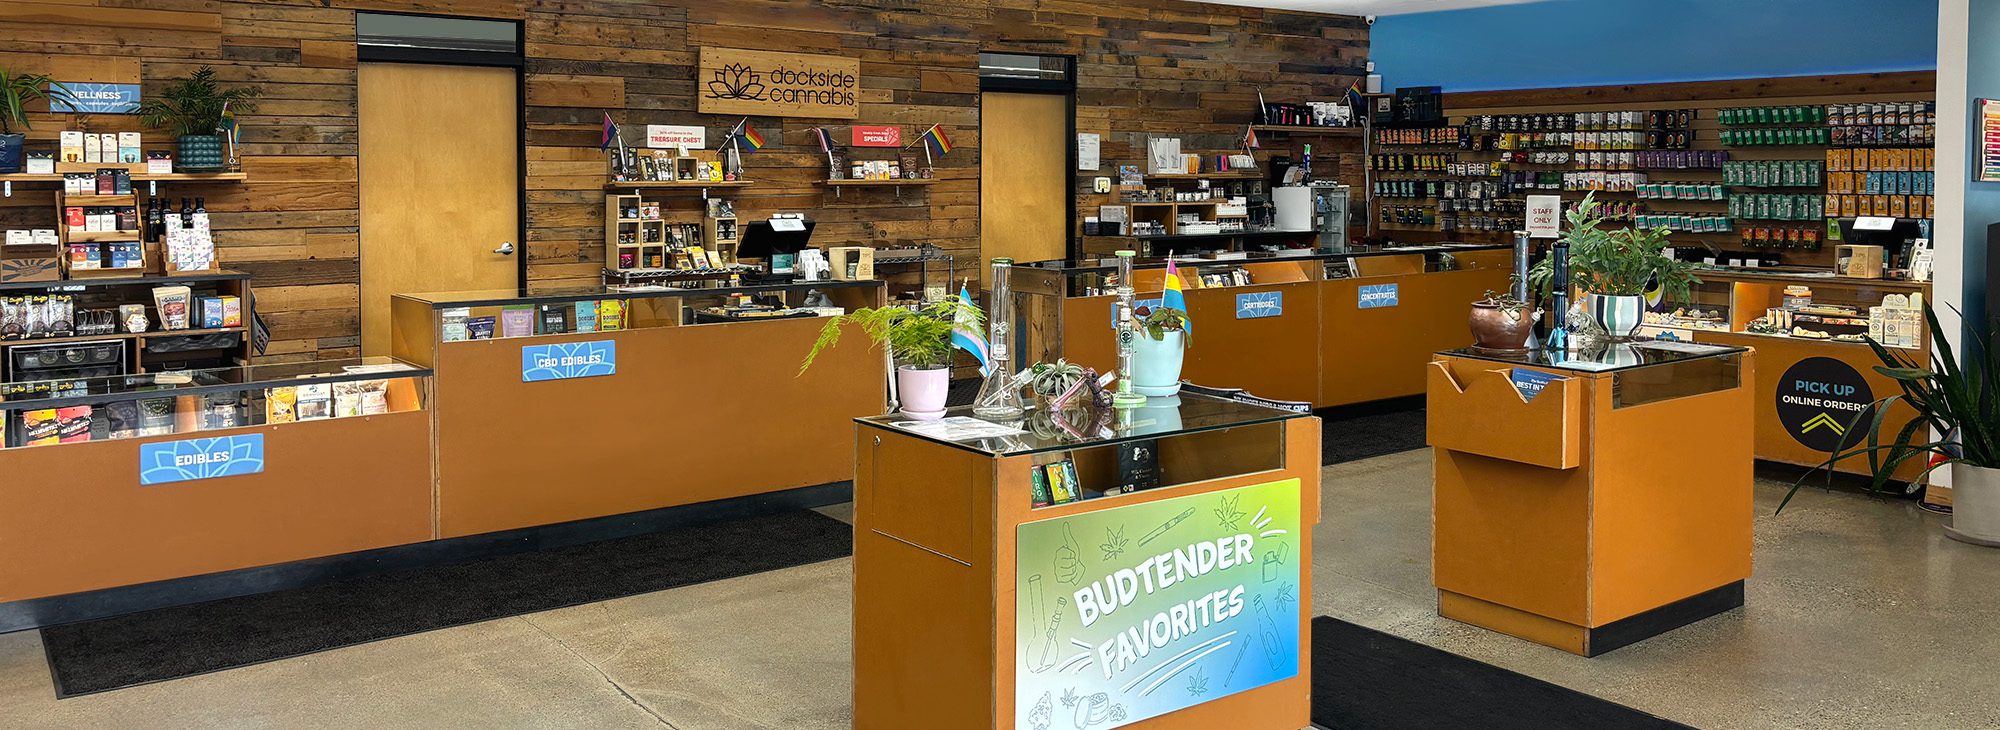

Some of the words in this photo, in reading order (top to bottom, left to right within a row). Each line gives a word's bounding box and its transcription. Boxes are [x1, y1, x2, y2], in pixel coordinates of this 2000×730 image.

[770, 65, 855, 89] dockside
[769, 87, 855, 106] cannabis
[1360, 291, 1396, 301] CONCENTRATES
[1243, 300, 1275, 310] CARTRIDGES
[538, 357, 558, 369] CBD
[561, 354, 602, 367] EDIBLES
[1516, 381, 1532, 390] BEST
[1795, 379, 1830, 395] PICK
[1833, 383, 1855, 396] UP
[1782, 395, 1822, 407] ONLINE
[175, 450, 230, 467] EDIBLES
[1032, 470, 1043, 497] AIRO
[1073, 532, 1255, 627] BUDTENDER
[1097, 583, 1246, 680] FAVORITES
